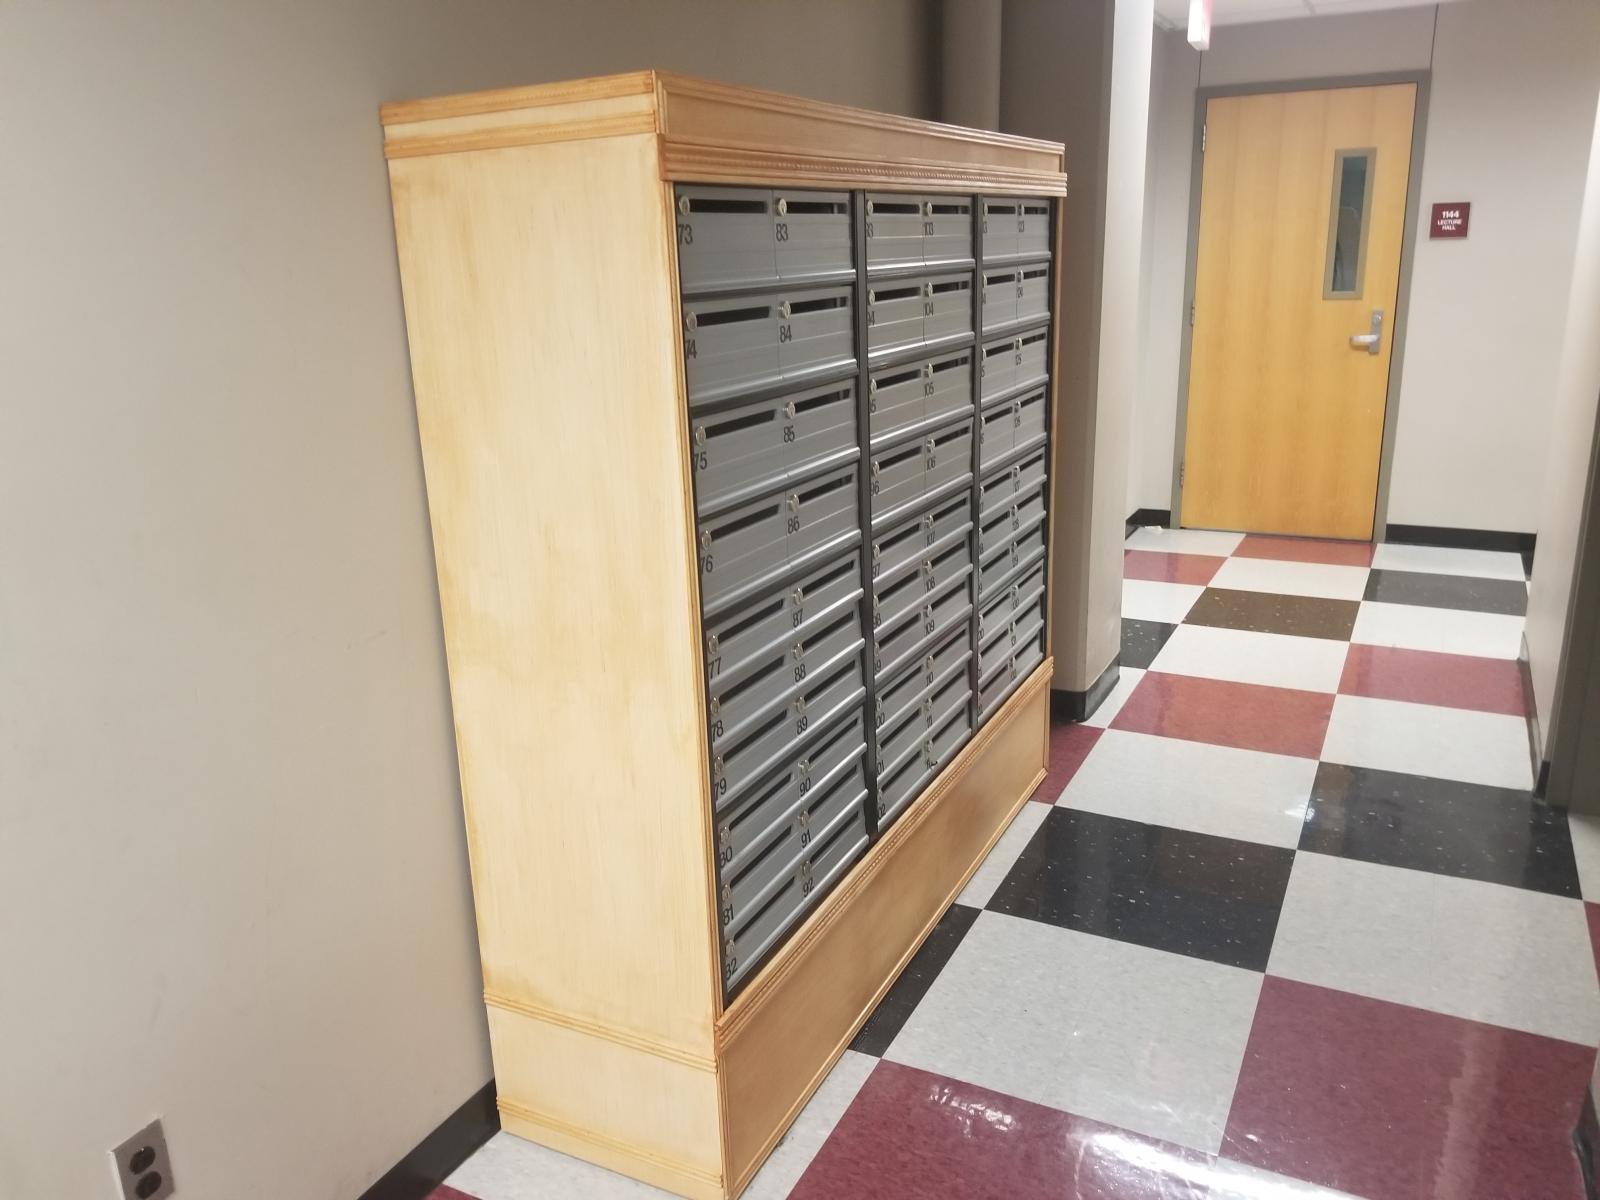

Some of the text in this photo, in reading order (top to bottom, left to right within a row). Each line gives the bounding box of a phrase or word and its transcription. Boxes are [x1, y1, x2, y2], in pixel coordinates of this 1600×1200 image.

[775, 223, 789, 242] 83
[779, 324, 793, 343] 84
[685, 338, 698, 359] 74
[783, 425, 796, 443] 85
[694, 450, 708, 473] 75
[787, 516, 800, 535] 86
[792, 608, 804, 628] 87
[708, 655, 722, 680] 77
[794, 663, 807, 683] 88
[711, 719, 724, 742] 78
[796, 715, 808, 735] 89
[713, 777, 727, 801] 79
[800, 777, 811, 797] 90
[801, 829, 811, 849] 91
[803, 877, 815, 898] 92
[722, 903, 735, 926] 81
